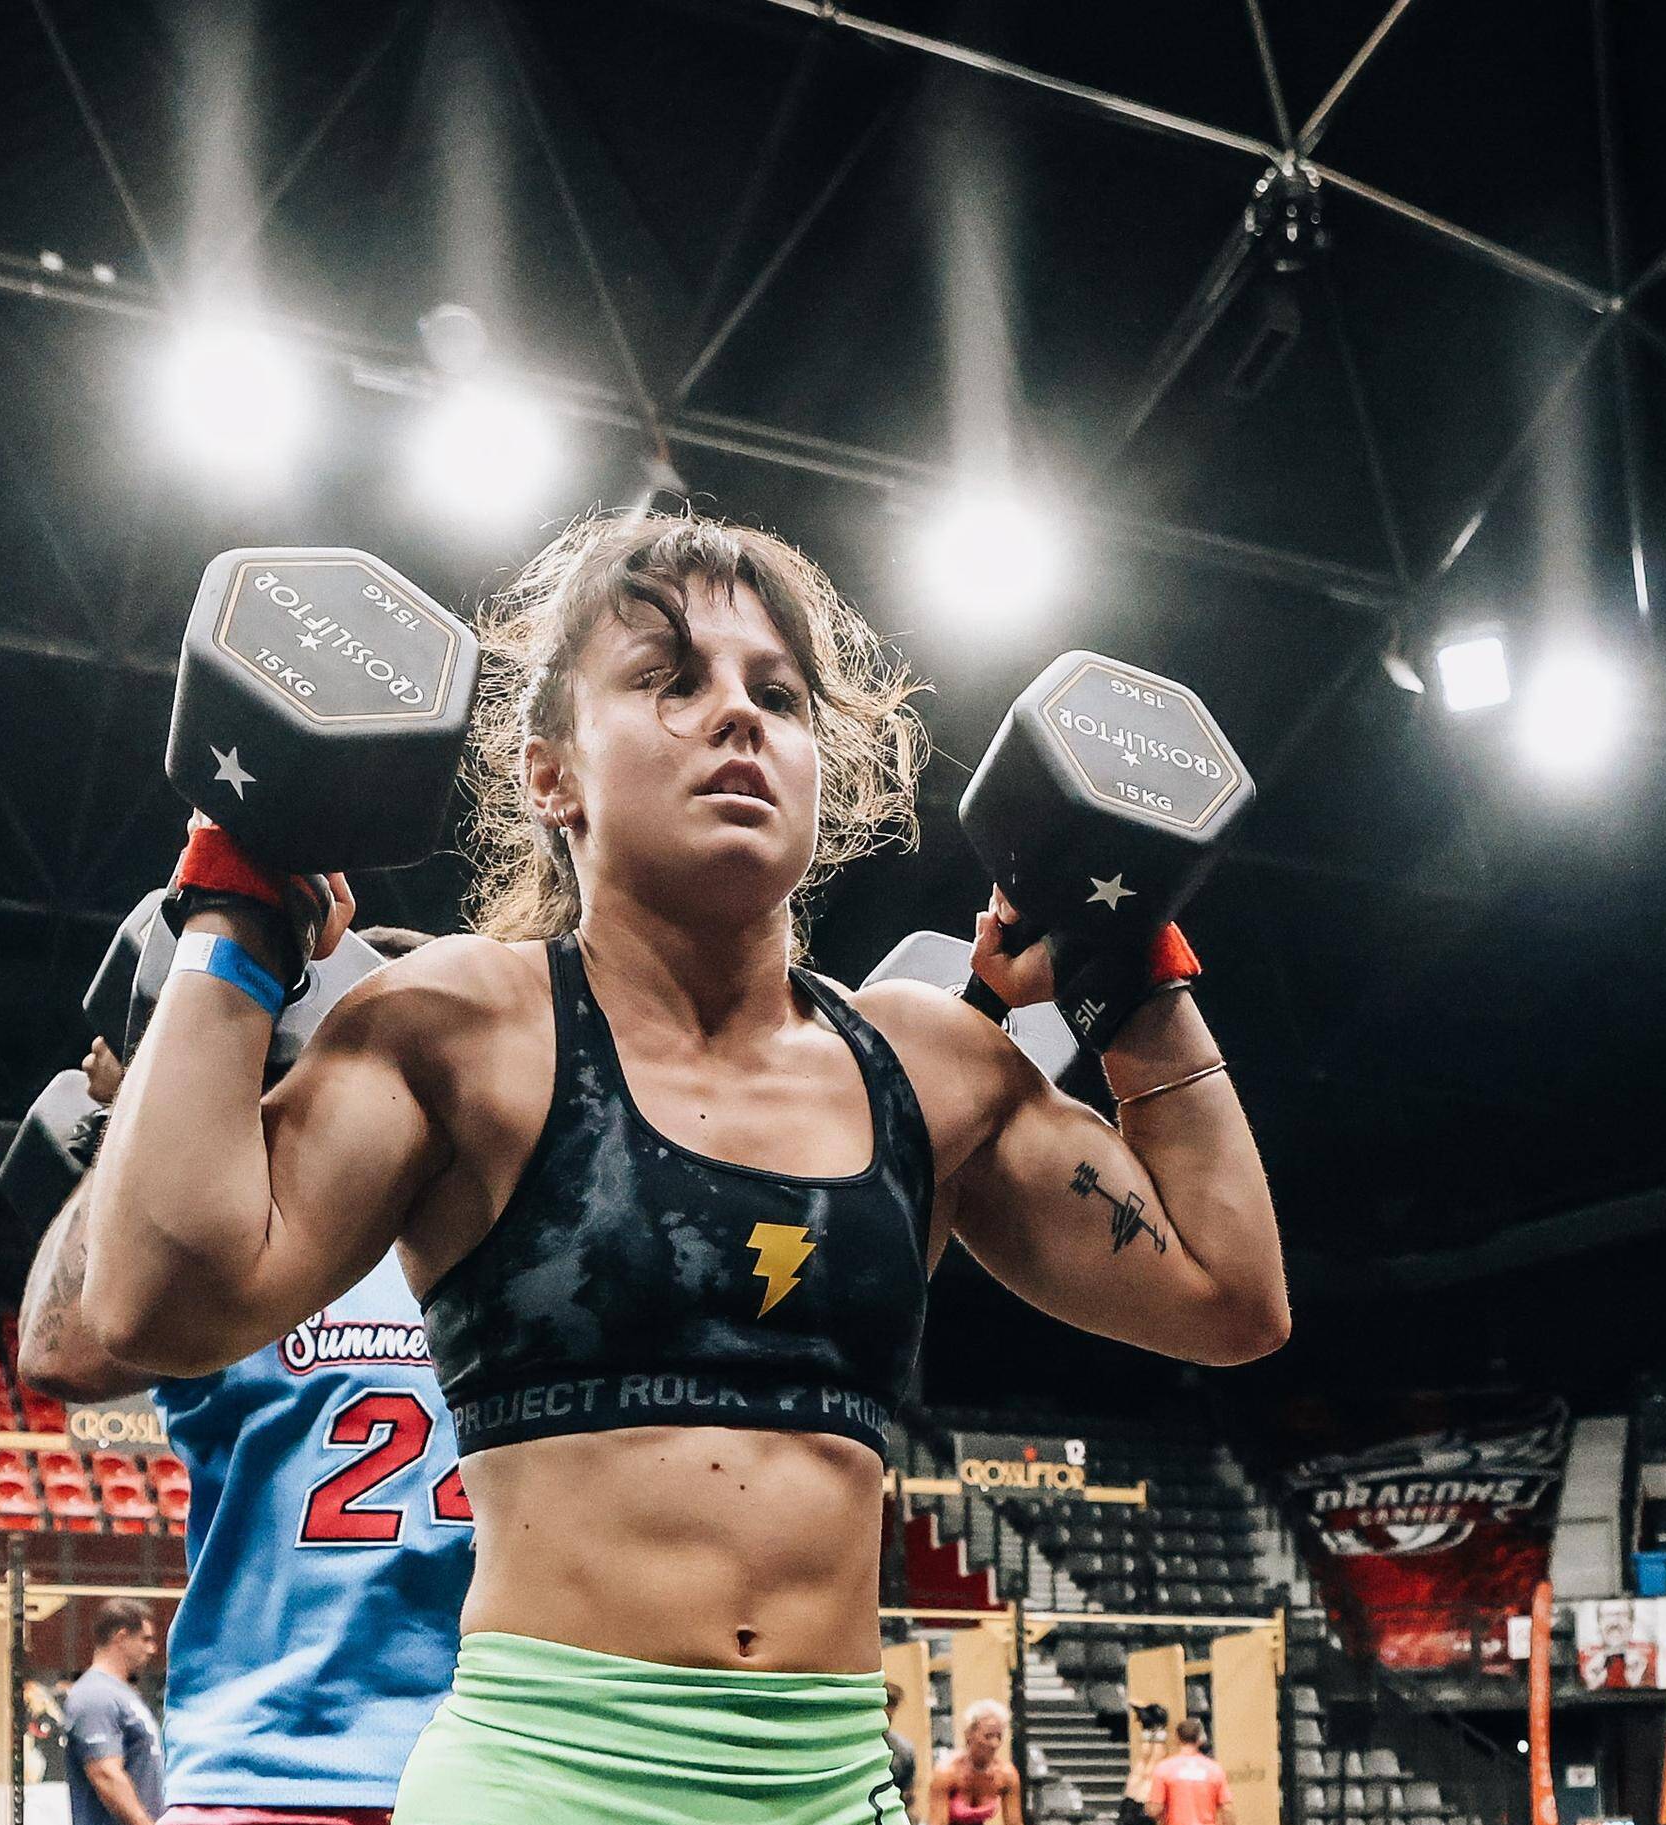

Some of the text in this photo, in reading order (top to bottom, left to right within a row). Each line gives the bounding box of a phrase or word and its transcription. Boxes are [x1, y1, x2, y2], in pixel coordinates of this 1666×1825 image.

[361, 584, 421, 631] 15KG
[254, 571, 424, 704] CROSSLIFTOR
[255, 648, 317, 697] 15KG
[1110, 679, 1166, 709] 15KG
[1058, 707, 1222, 779] CROSSLIFTOR
[1116, 781, 1173, 811] 15KG
[281, 1310, 432, 1372] Summe
[452, 1377, 605, 1438] PROJECT
[1315, 1479, 1524, 1512] DRAGONS
